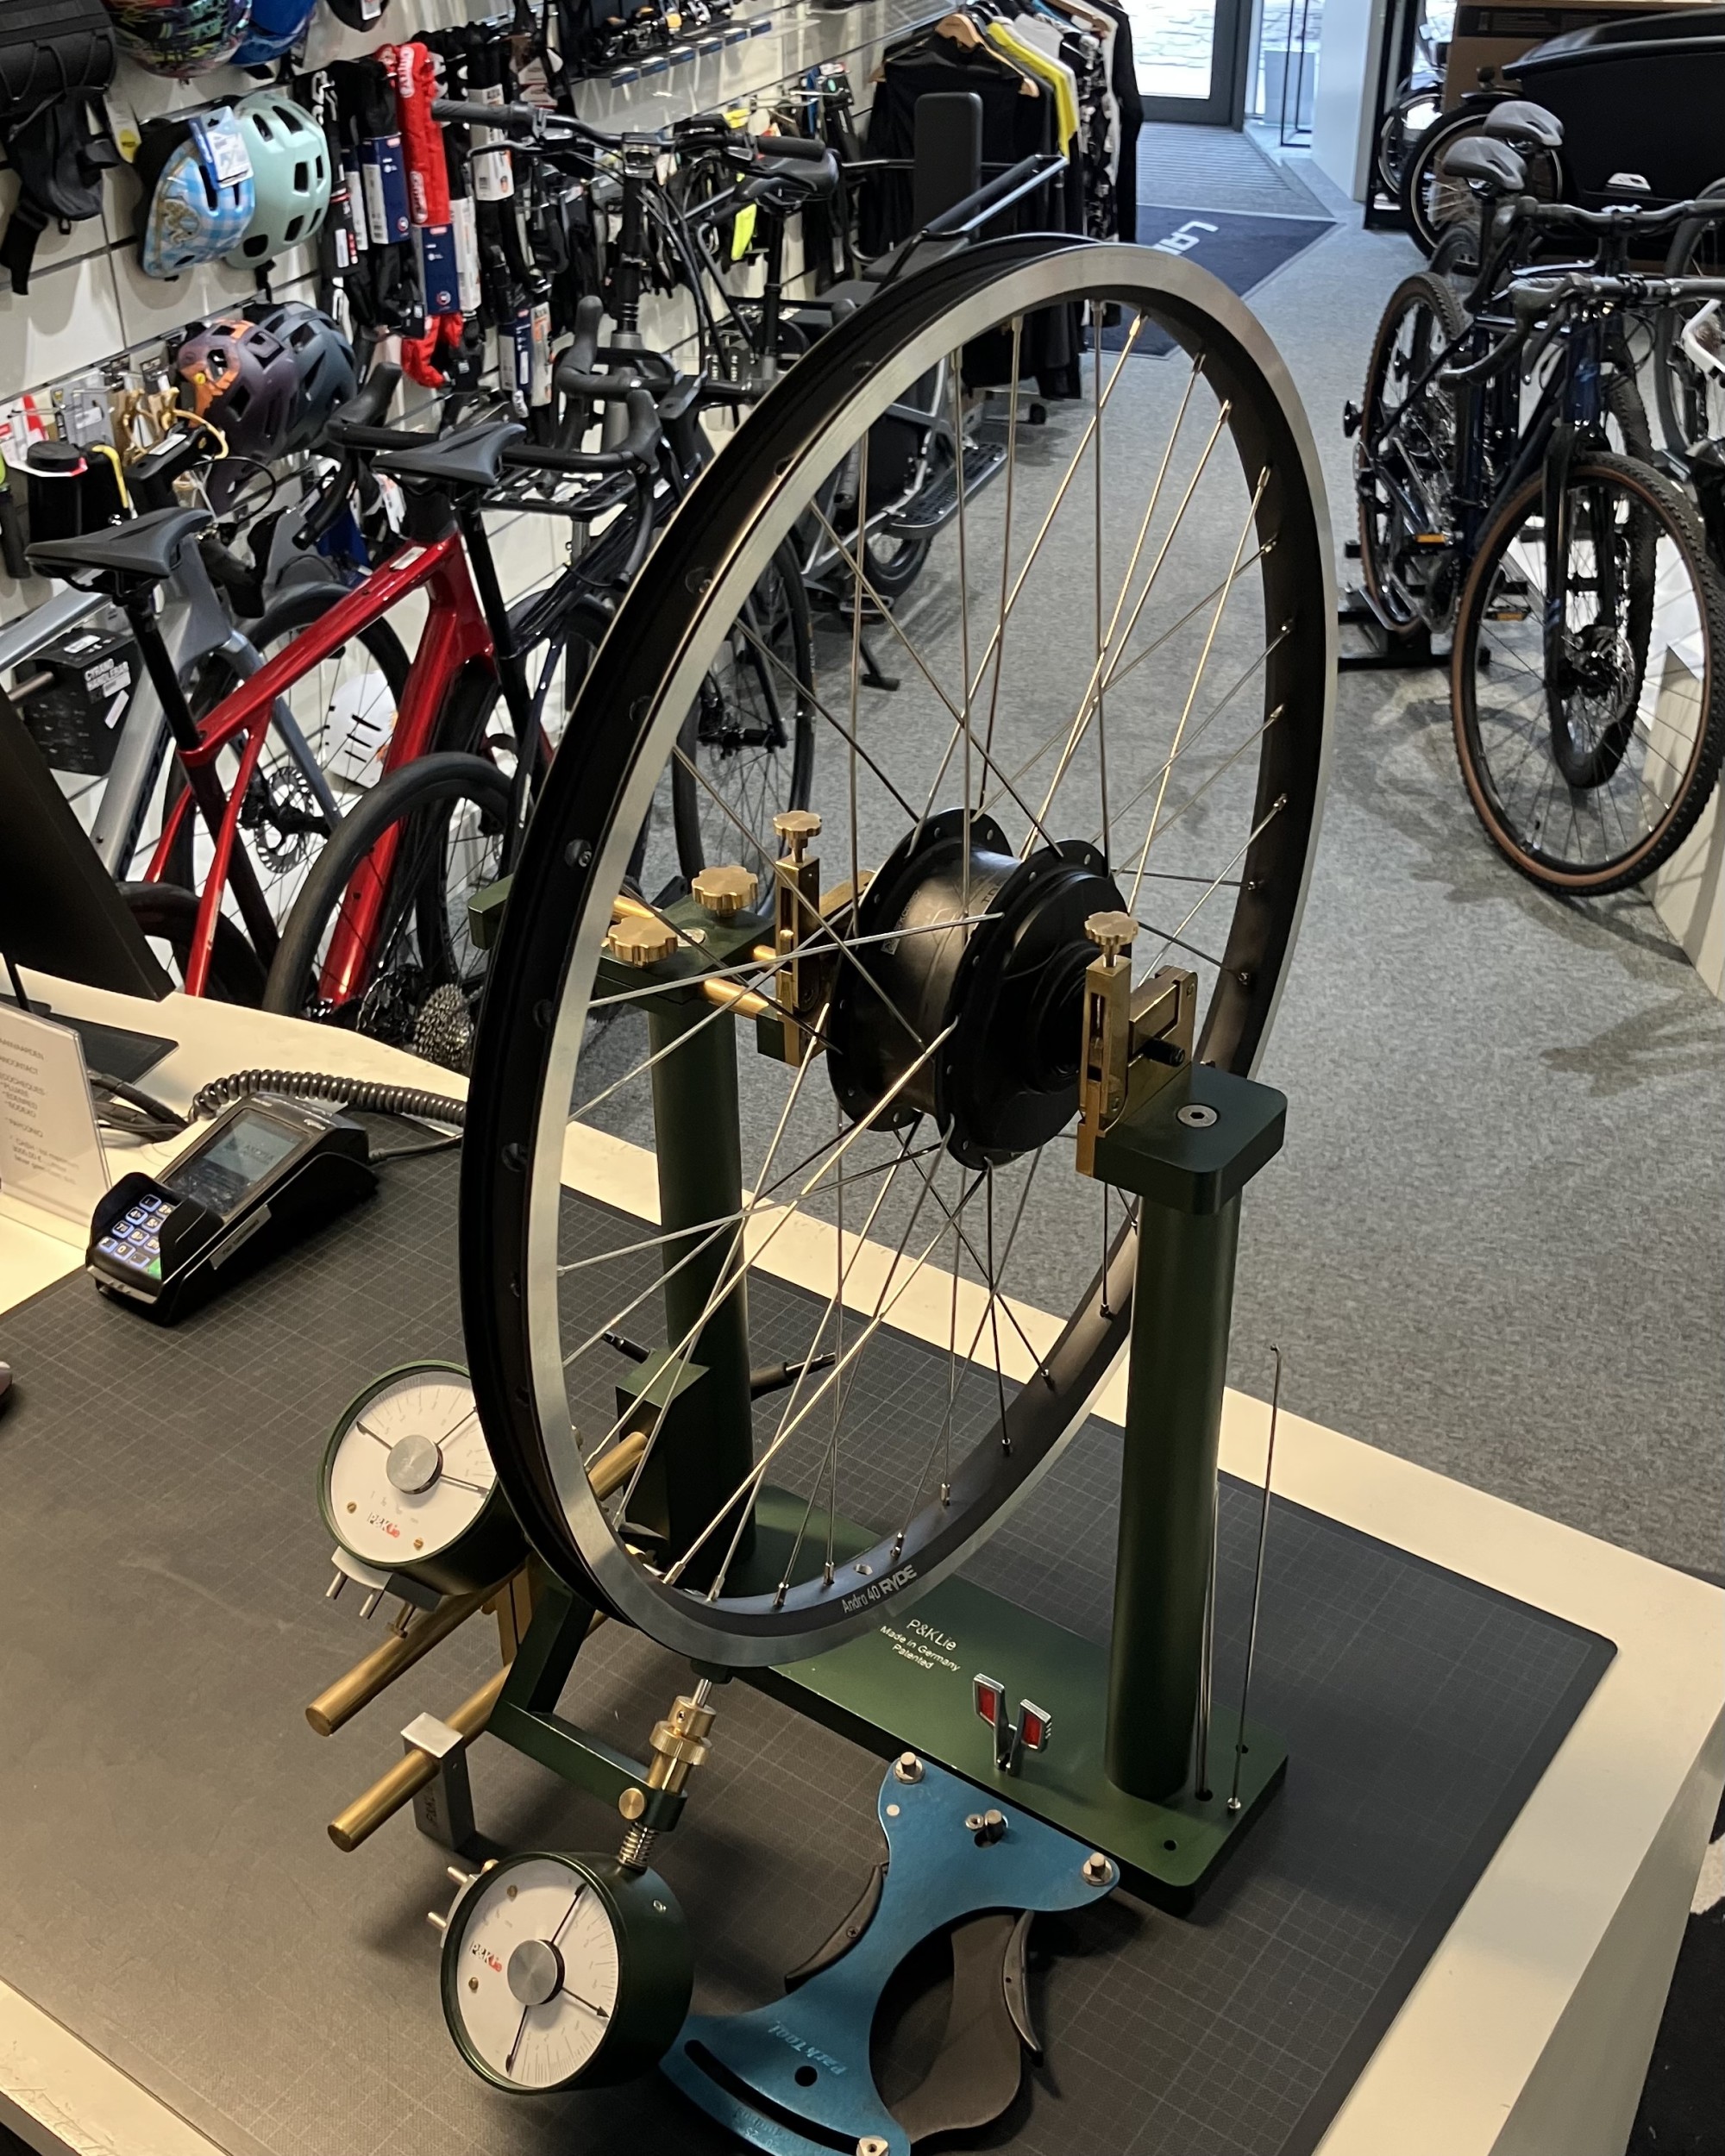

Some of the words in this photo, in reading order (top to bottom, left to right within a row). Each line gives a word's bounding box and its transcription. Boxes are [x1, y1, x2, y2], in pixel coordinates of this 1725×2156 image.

[842, 1591, 869, 1614] Andro
[867, 1584, 881, 1601] 40
[878, 1564, 918, 1595] RYDE
[880, 1625, 907, 1644] Made
[906, 1639, 918, 1649] in
[917, 1645, 962, 1672] Germany
[906, 1619, 957, 1651] P&KLie
[891, 1643, 935, 1670] Patented
[767, 2021, 807, 2053] Tool
[805, 2046, 847, 2075] Park
